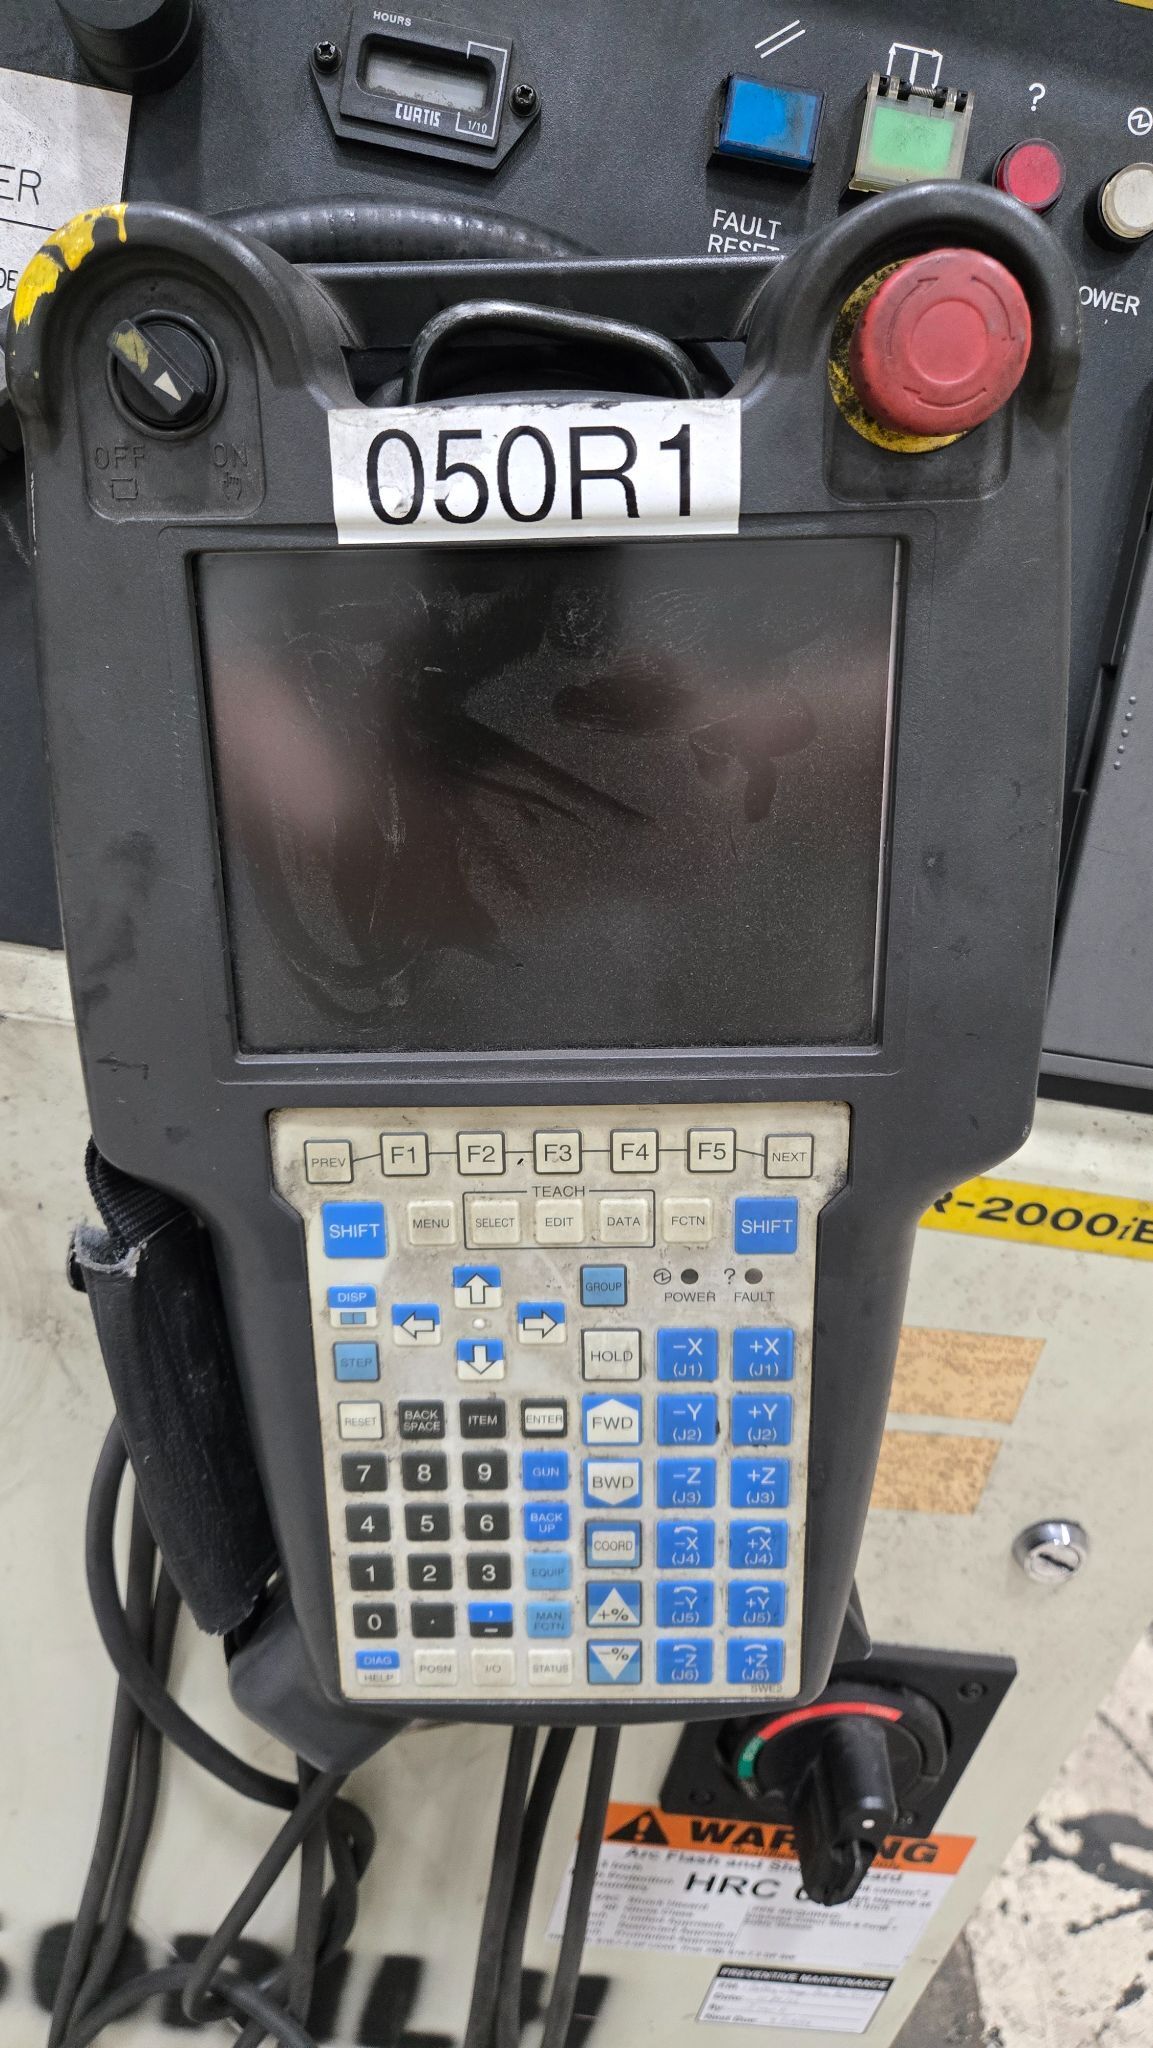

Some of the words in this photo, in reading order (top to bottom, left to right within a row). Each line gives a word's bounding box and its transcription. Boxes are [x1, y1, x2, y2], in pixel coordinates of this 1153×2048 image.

[373, 10, 412, 27] HOURS
[395, 103, 441, 128] CURTIS
[467, 120, 488, 134] 1/10
[712, 208, 782, 241] FAULT
[707, 233, 780, 253] RES
[1079, 285, 1140, 316] OWER
[94, 443, 146, 470] OFF
[213, 442, 248, 468] ON
[366, 424, 692, 526] 050R1
[390, 1146, 416, 1164] F1
[467, 1145, 496, 1163] F2
[543, 1144, 573, 1162] F3
[620, 1143, 650, 1161] F4
[698, 1142, 727, 1160] F5
[772, 1151, 807, 1163] NEXT
[311, 1157, 346, 1168] PREV
[531, 1185, 585, 1197] TEACH
[412, 1218, 450, 1229] MENU
[475, 1218, 515, 1229] SELECT
[545, 1217, 574, 1228] EDIT
[606, 1216, 641, 1227] DATA
[671, 1216, 705, 1226] FCTN
[741, 1219, 793, 1235] SHIFT
[329, 1223, 380, 1239] SHIFT
[585, 1281, 622, 1292] GROUP
[337, 1292, 367, 1302] DISP
[664, 1291, 716, 1303] POWER
[734, 1291, 775, 1302] FAULT
[749, 1337, 780, 1356] +X
[340, 1357, 373, 1369] STEP
[590, 1350, 633, 1363] HOLD
[673, 1362, 703, 1378] (J1)
[749, 1363, 779, 1378] (J1)
[404, 1410, 439, 1421] BACK
[748, 1403, 778, 1421] +Y
[344, 1416, 377, 1427] RESET
[468, 1415, 498, 1426] ITEM
[526, 1414, 563, 1425] ENTER
[592, 1416, 633, 1430] FWD
[403, 1421, 441, 1433] SPACE
[672, 1427, 702, 1442] (J2)
[747, 1427, 777, 1442] (J2)
[356, 1464, 371, 1483] 7
[417, 1463, 432, 1482] 8
[477, 1463, 492, 1482] 9
[532, 1467, 559, 1478] GUN
[747, 1467, 776, 1484] +Z
[592, 1475, 634, 1489] BWD
[672, 1491, 701, 1504] (J3)
[746, 1491, 775, 1504] (J3)
[360, 1515, 375, 1533] 4
[420, 1514, 435, 1532] 5
[480, 1514, 494, 1532] 6
[530, 1513, 563, 1523] BACK
[539, 1524, 556, 1533] UP
[593, 1540, 633, 1551] COORD
[747, 1537, 772, 1550] +X
[671, 1552, 700, 1565] (J4)
[744, 1552, 773, 1565] (J4)
[365, 1565, 376, 1583] 1
[423, 1565, 438, 1582] 2
[482, 1564, 496, 1582] 3
[531, 1567, 565, 1577] EQUIP
[746, 1596, 770, 1610] +Y
[367, 1613, 383, 1631] 0
[536, 1611, 562, 1621] MAN
[599, 1608, 629, 1622] +%
[671, 1611, 700, 1624] (J5)
[743, 1611, 771, 1624] (J5)
[364, 1656, 392, 1666] DIAG
[745, 1654, 768, 1667] +Z
[533, 1664, 569, 1674] STATUS
[671, 1668, 699, 1681] (J6)
[742, 1668, 770, 1681] (J6)
[690, 1820, 939, 1864] WARNG
[625, 1849, 660, 1861] Arc
[665, 1852, 721, 1867] Flash
[726, 1859, 762, 1870] and
[685, 1872, 780, 1899] HRC
